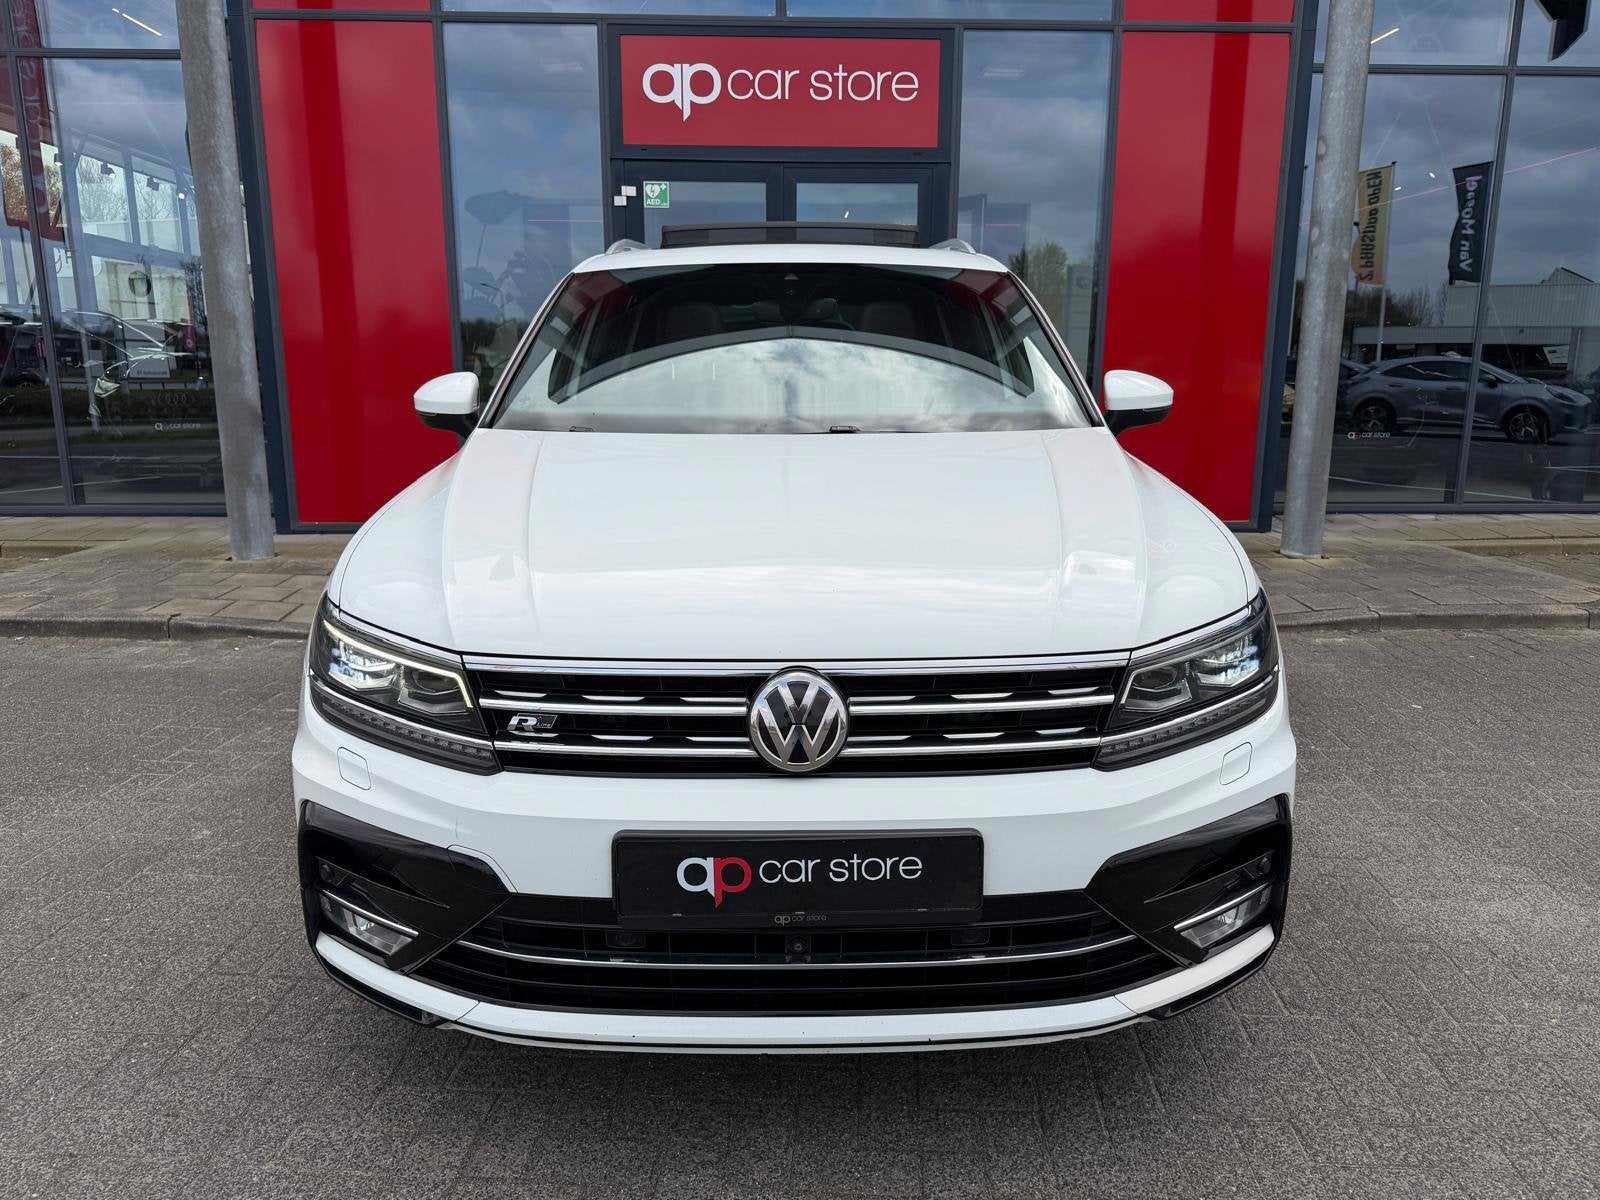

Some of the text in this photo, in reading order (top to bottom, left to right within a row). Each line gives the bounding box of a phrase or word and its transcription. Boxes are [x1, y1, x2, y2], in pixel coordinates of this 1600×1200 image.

[642, 63, 919, 122] ap car store
[506, 715, 537, 731] R
[676, 853, 922, 908] ap car store
[774, 915, 790, 926] ap
[806, 913, 827, 921] store
